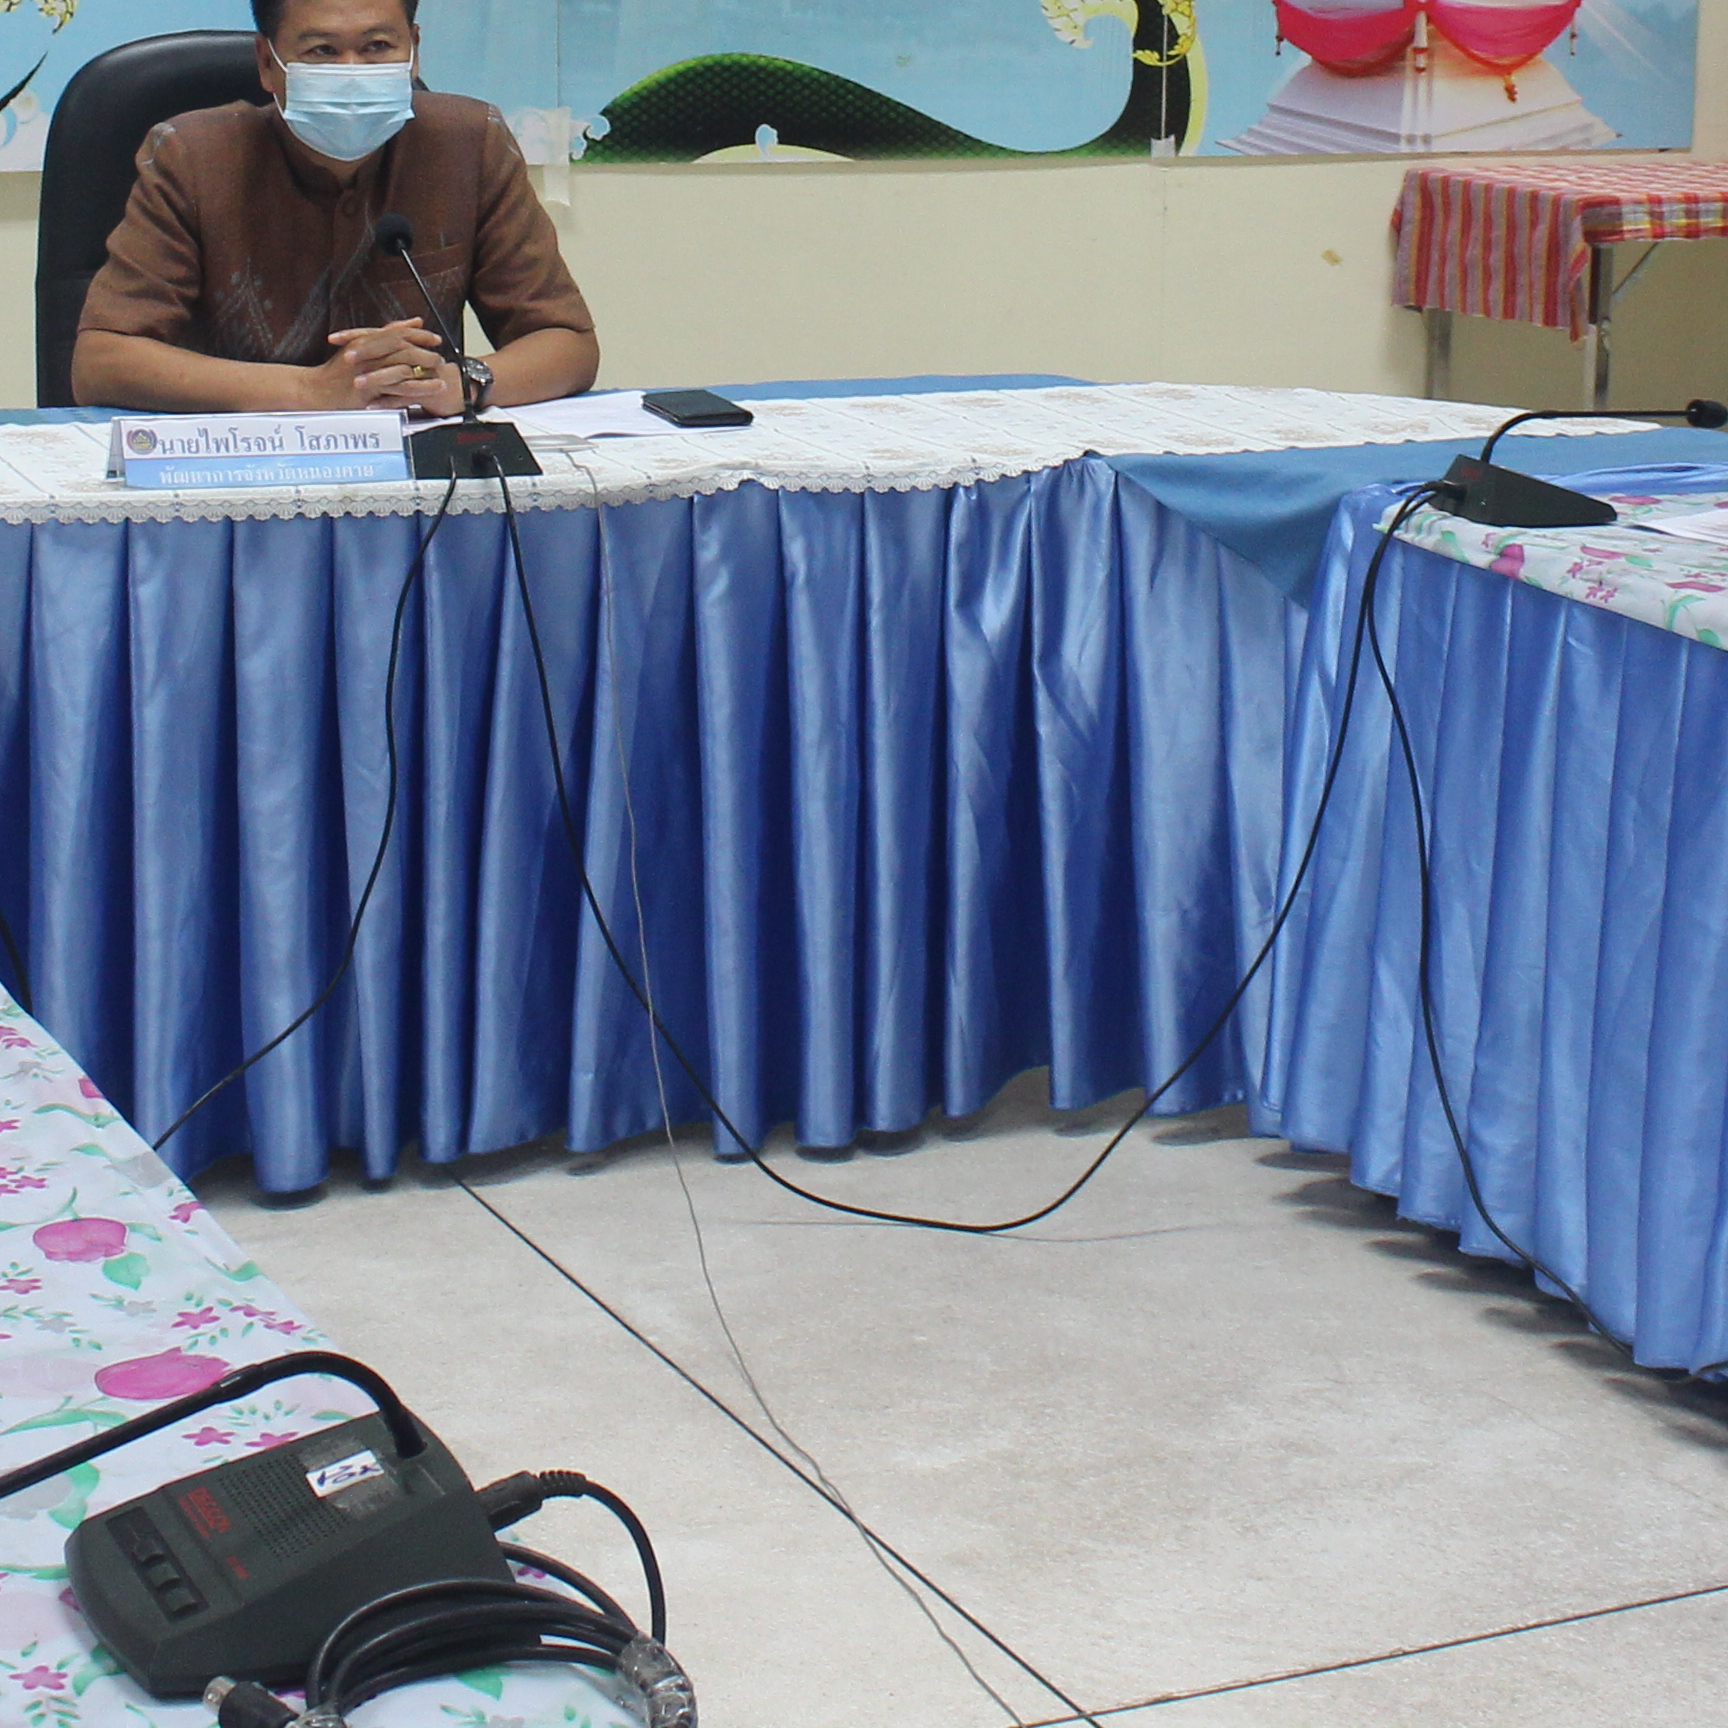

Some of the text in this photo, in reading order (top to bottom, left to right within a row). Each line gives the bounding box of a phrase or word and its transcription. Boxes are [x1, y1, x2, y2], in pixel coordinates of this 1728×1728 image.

[157, 424, 381, 455] นายไพโรจน์ โสภาพร
